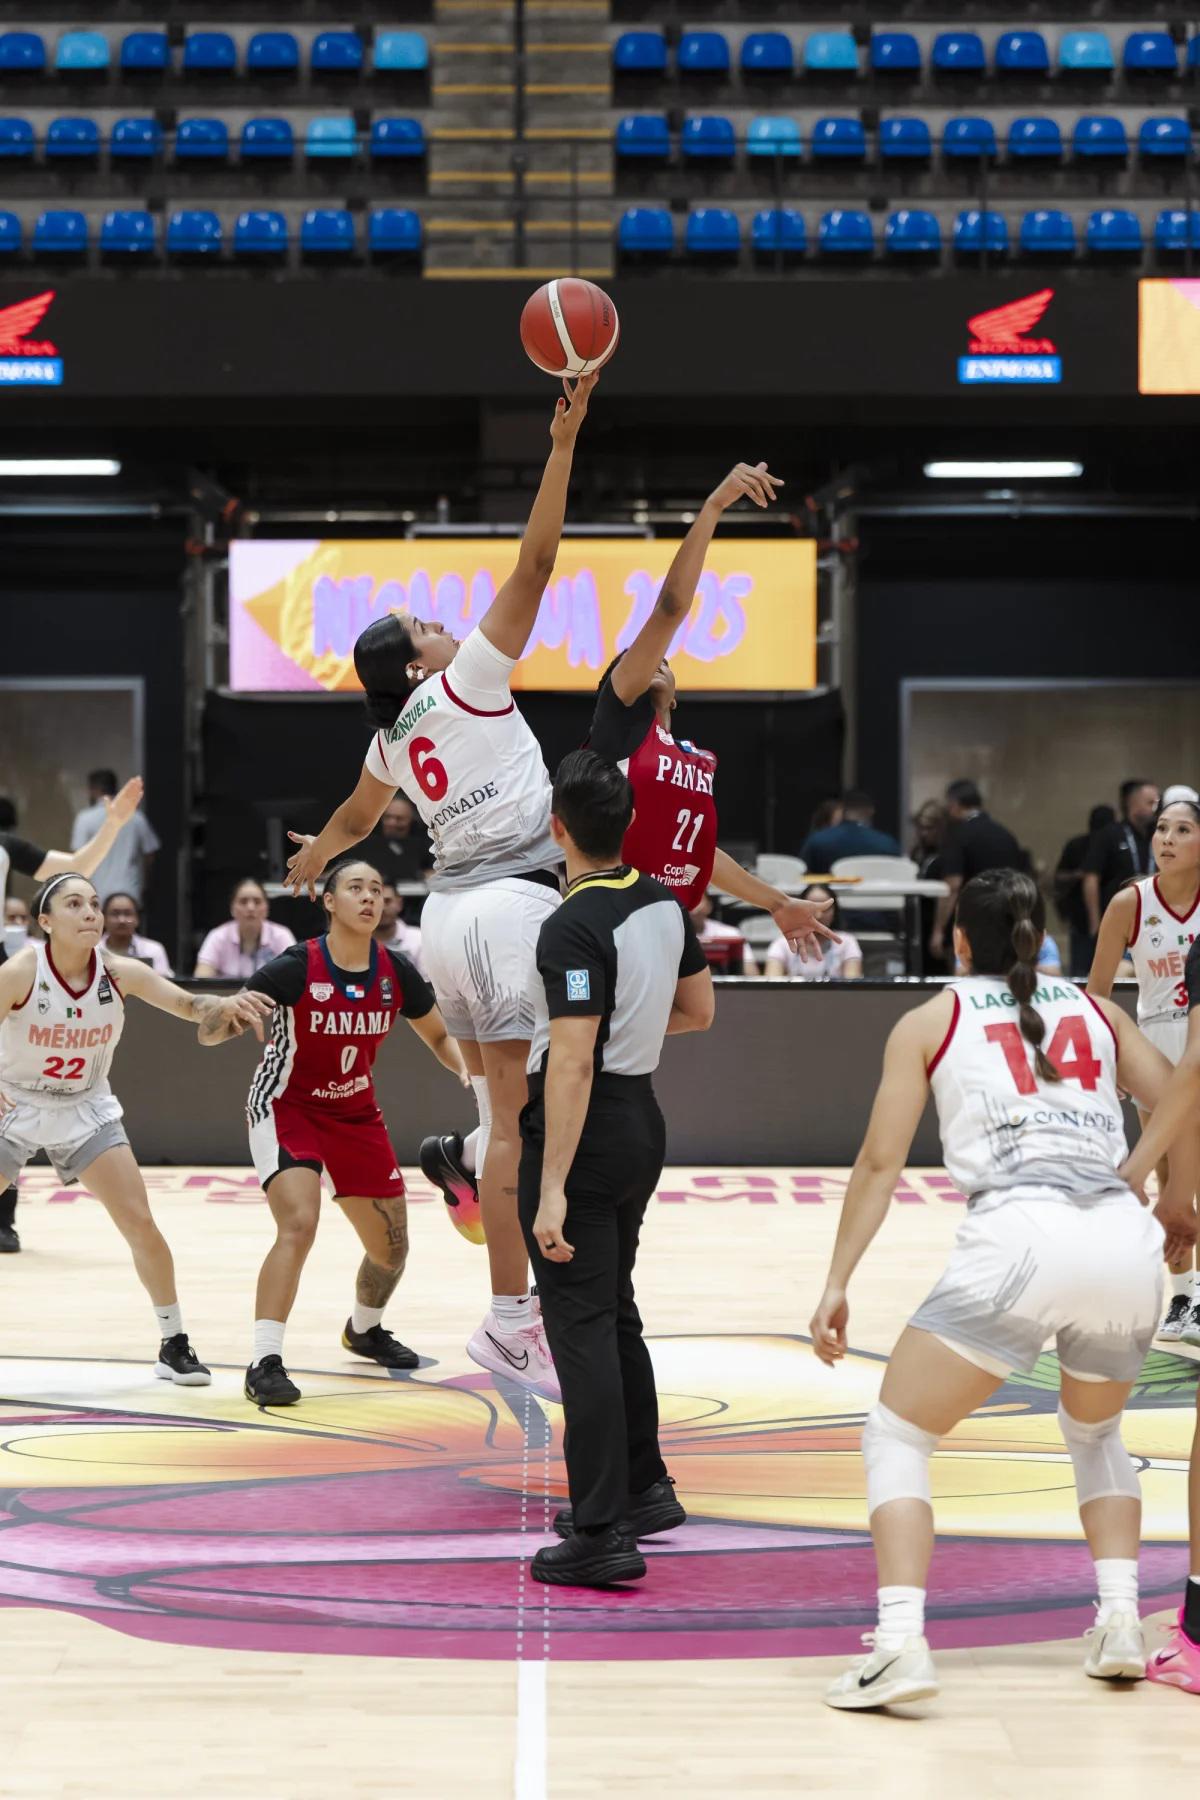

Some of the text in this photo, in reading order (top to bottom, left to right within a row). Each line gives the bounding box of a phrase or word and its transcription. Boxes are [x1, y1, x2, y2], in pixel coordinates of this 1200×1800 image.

[408, 736, 449, 802] 6
[434, 781, 500, 827] CONADE
[671, 808, 705, 853] 21
[969, 985, 1080, 1010] LAGNAS
[310, 1011, 391, 1035] PANAMA
[42, 1056, 86, 1080] 22
[340, 1045, 359, 1075] 0
[984, 1015, 1102, 1096] 14
[311, 1087, 354, 1100] Airlines
[328, 1079, 354, 1092] Copa
